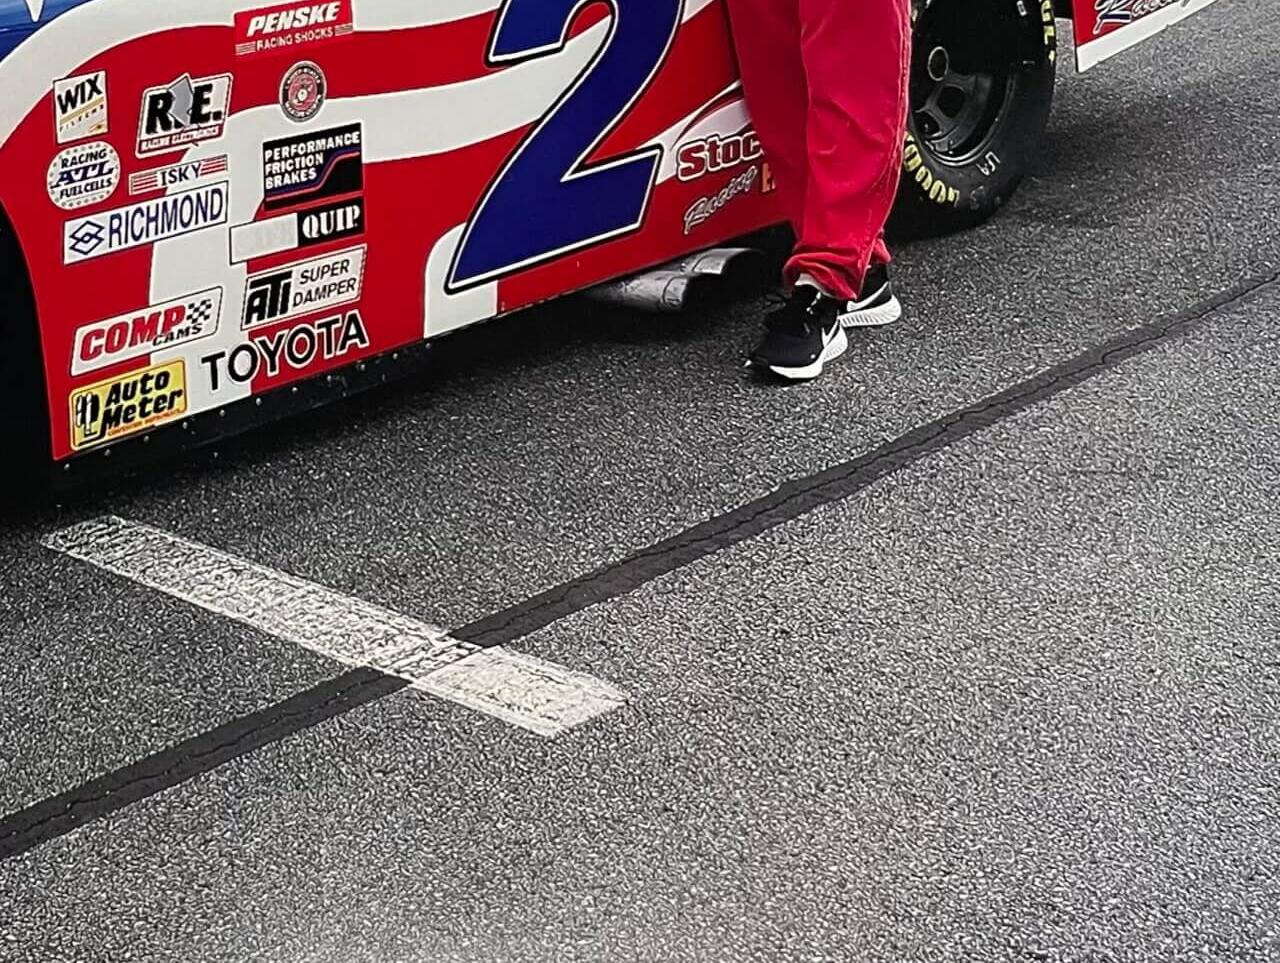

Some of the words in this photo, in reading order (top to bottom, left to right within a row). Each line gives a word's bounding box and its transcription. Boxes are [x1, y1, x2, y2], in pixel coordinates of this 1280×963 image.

[247, 1, 341, 37] PENSKE
[256, 36, 293, 51] RACING
[295, 27, 334, 43] SHOCKS
[57, 73, 103, 115] WIX
[60, 148, 108, 169] RACING
[264, 132, 361, 162] PERFORMANCE
[265, 152, 324, 175] FRICTION
[677, 130, 765, 182] Stoc
[160, 162, 202, 186] ISKY
[265, 167, 317, 189] BRAKES
[108, 188, 223, 248] RICHMOND
[302, 204, 361, 239] QUIP
[299, 258, 351, 285] SUPER
[292, 277, 357, 308] DAMPER
[80, 305, 185, 362] COMP
[152, 323, 203, 347] CAMS
[201, 311, 368, 391] TOYOTA
[105, 369, 170, 408] Auto
[100, 388, 183, 437] Meter
